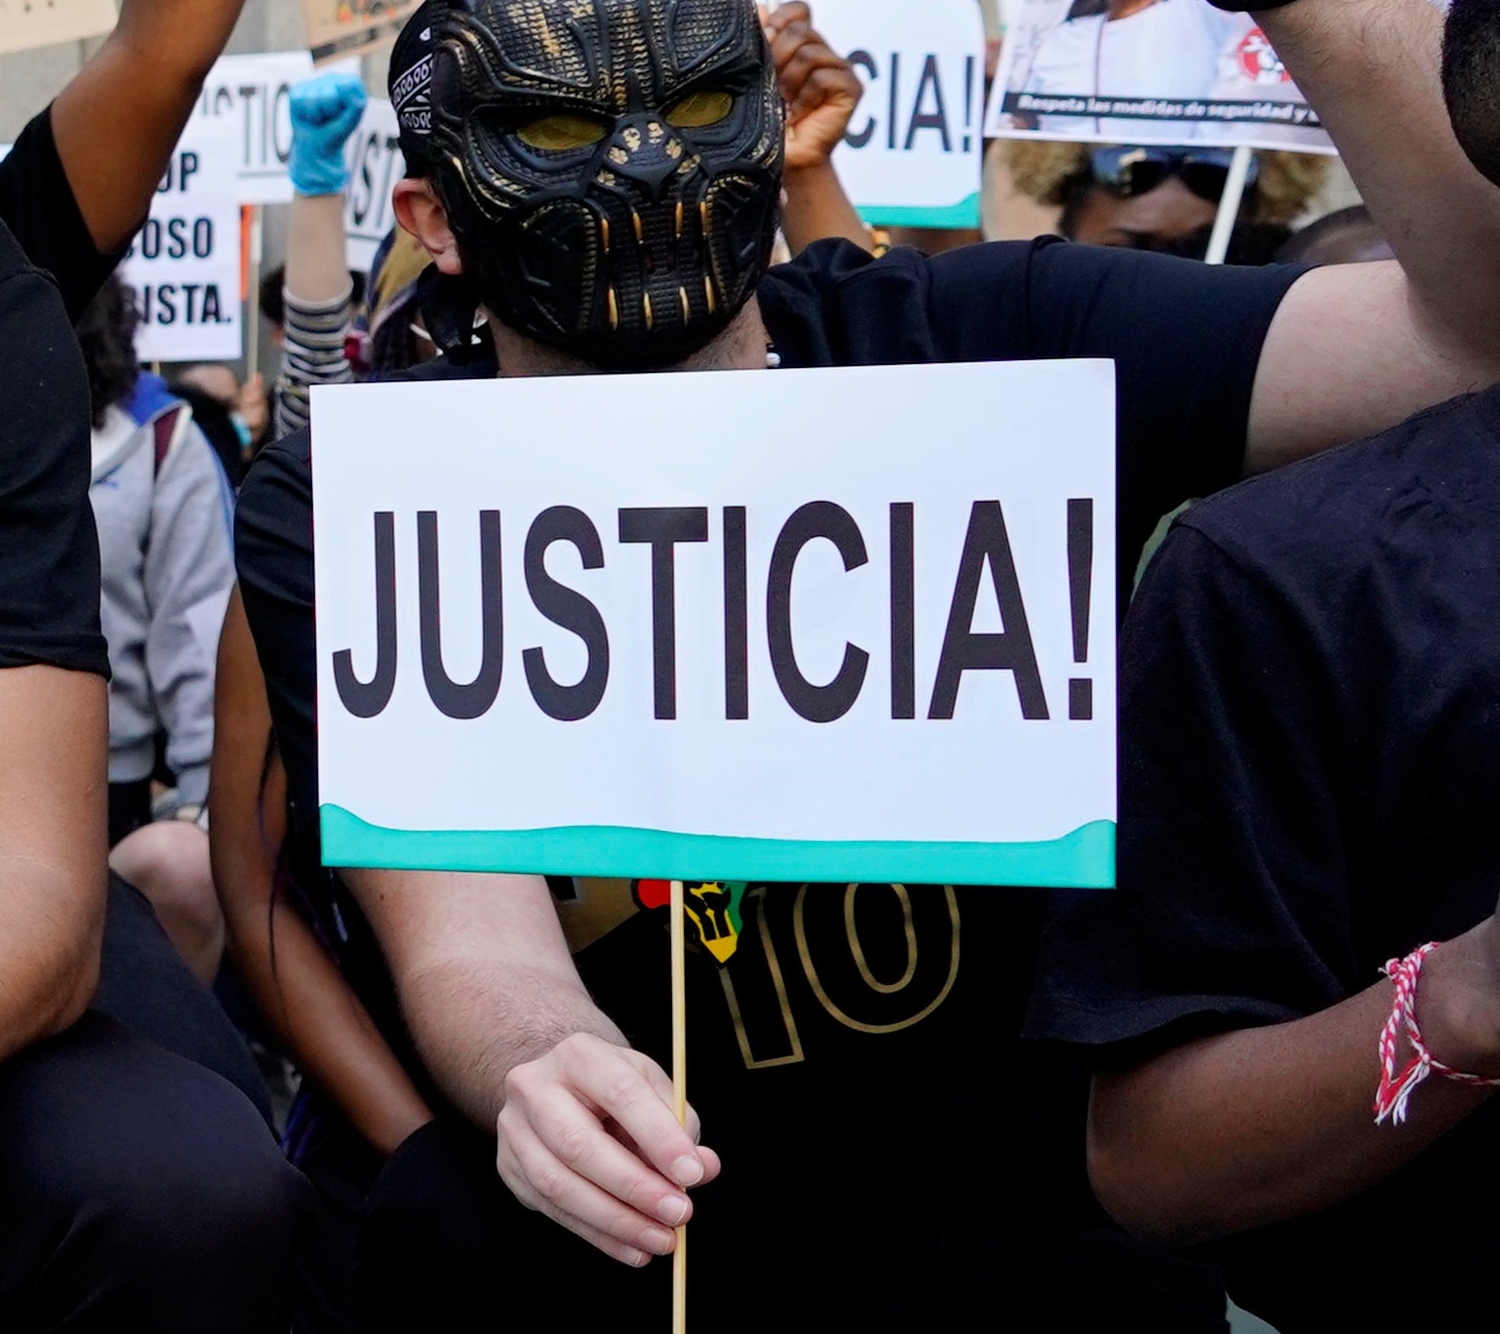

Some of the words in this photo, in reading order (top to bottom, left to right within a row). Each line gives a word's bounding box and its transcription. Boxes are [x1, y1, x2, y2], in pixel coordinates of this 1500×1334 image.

[841, 50, 976, 154] CIA!
[1207, 101, 1294, 121] seguridad
[125, 216, 215, 261] OSO
[134, 283, 233, 326] ISTA.
[331, 497, 1095, 724] JUSTICIA!
